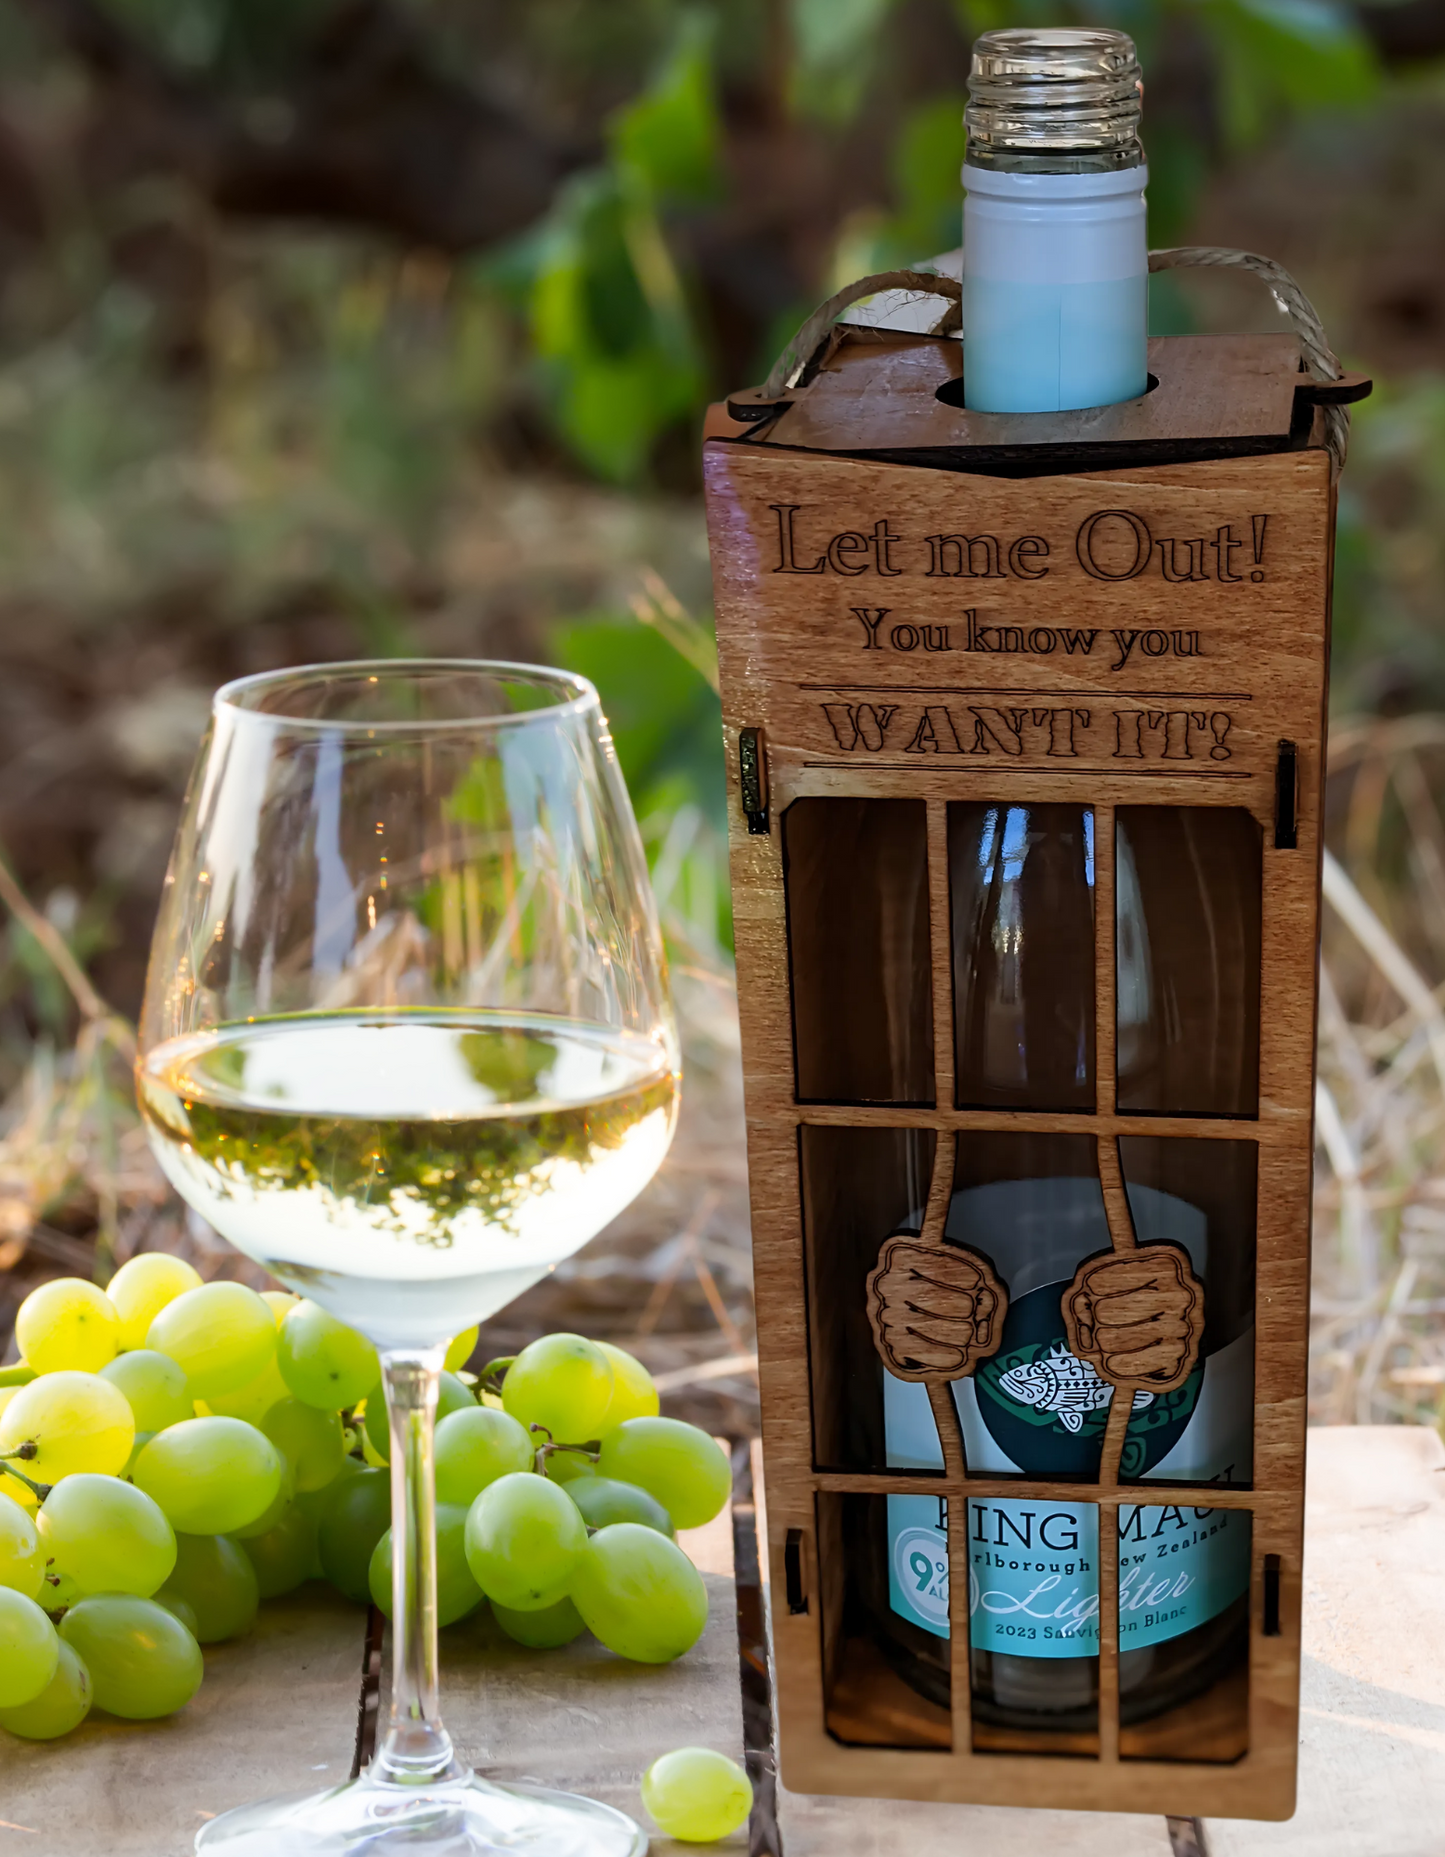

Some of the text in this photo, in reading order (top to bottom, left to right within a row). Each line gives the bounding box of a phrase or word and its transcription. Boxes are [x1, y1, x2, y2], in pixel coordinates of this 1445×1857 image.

[769, 504, 1269, 583] Let me Out!
[850, 607, 1201, 671] You know you
[821, 703, 1233, 761] WANT IT!
[973, 1552, 1091, 1576] rlborough
[1156, 1513, 1228, 1558] Zealand
[928, 1584, 949, 1602] AL
[995, 1623, 1037, 1640] 2023
[1143, 1605, 1187, 1628] Blanc
